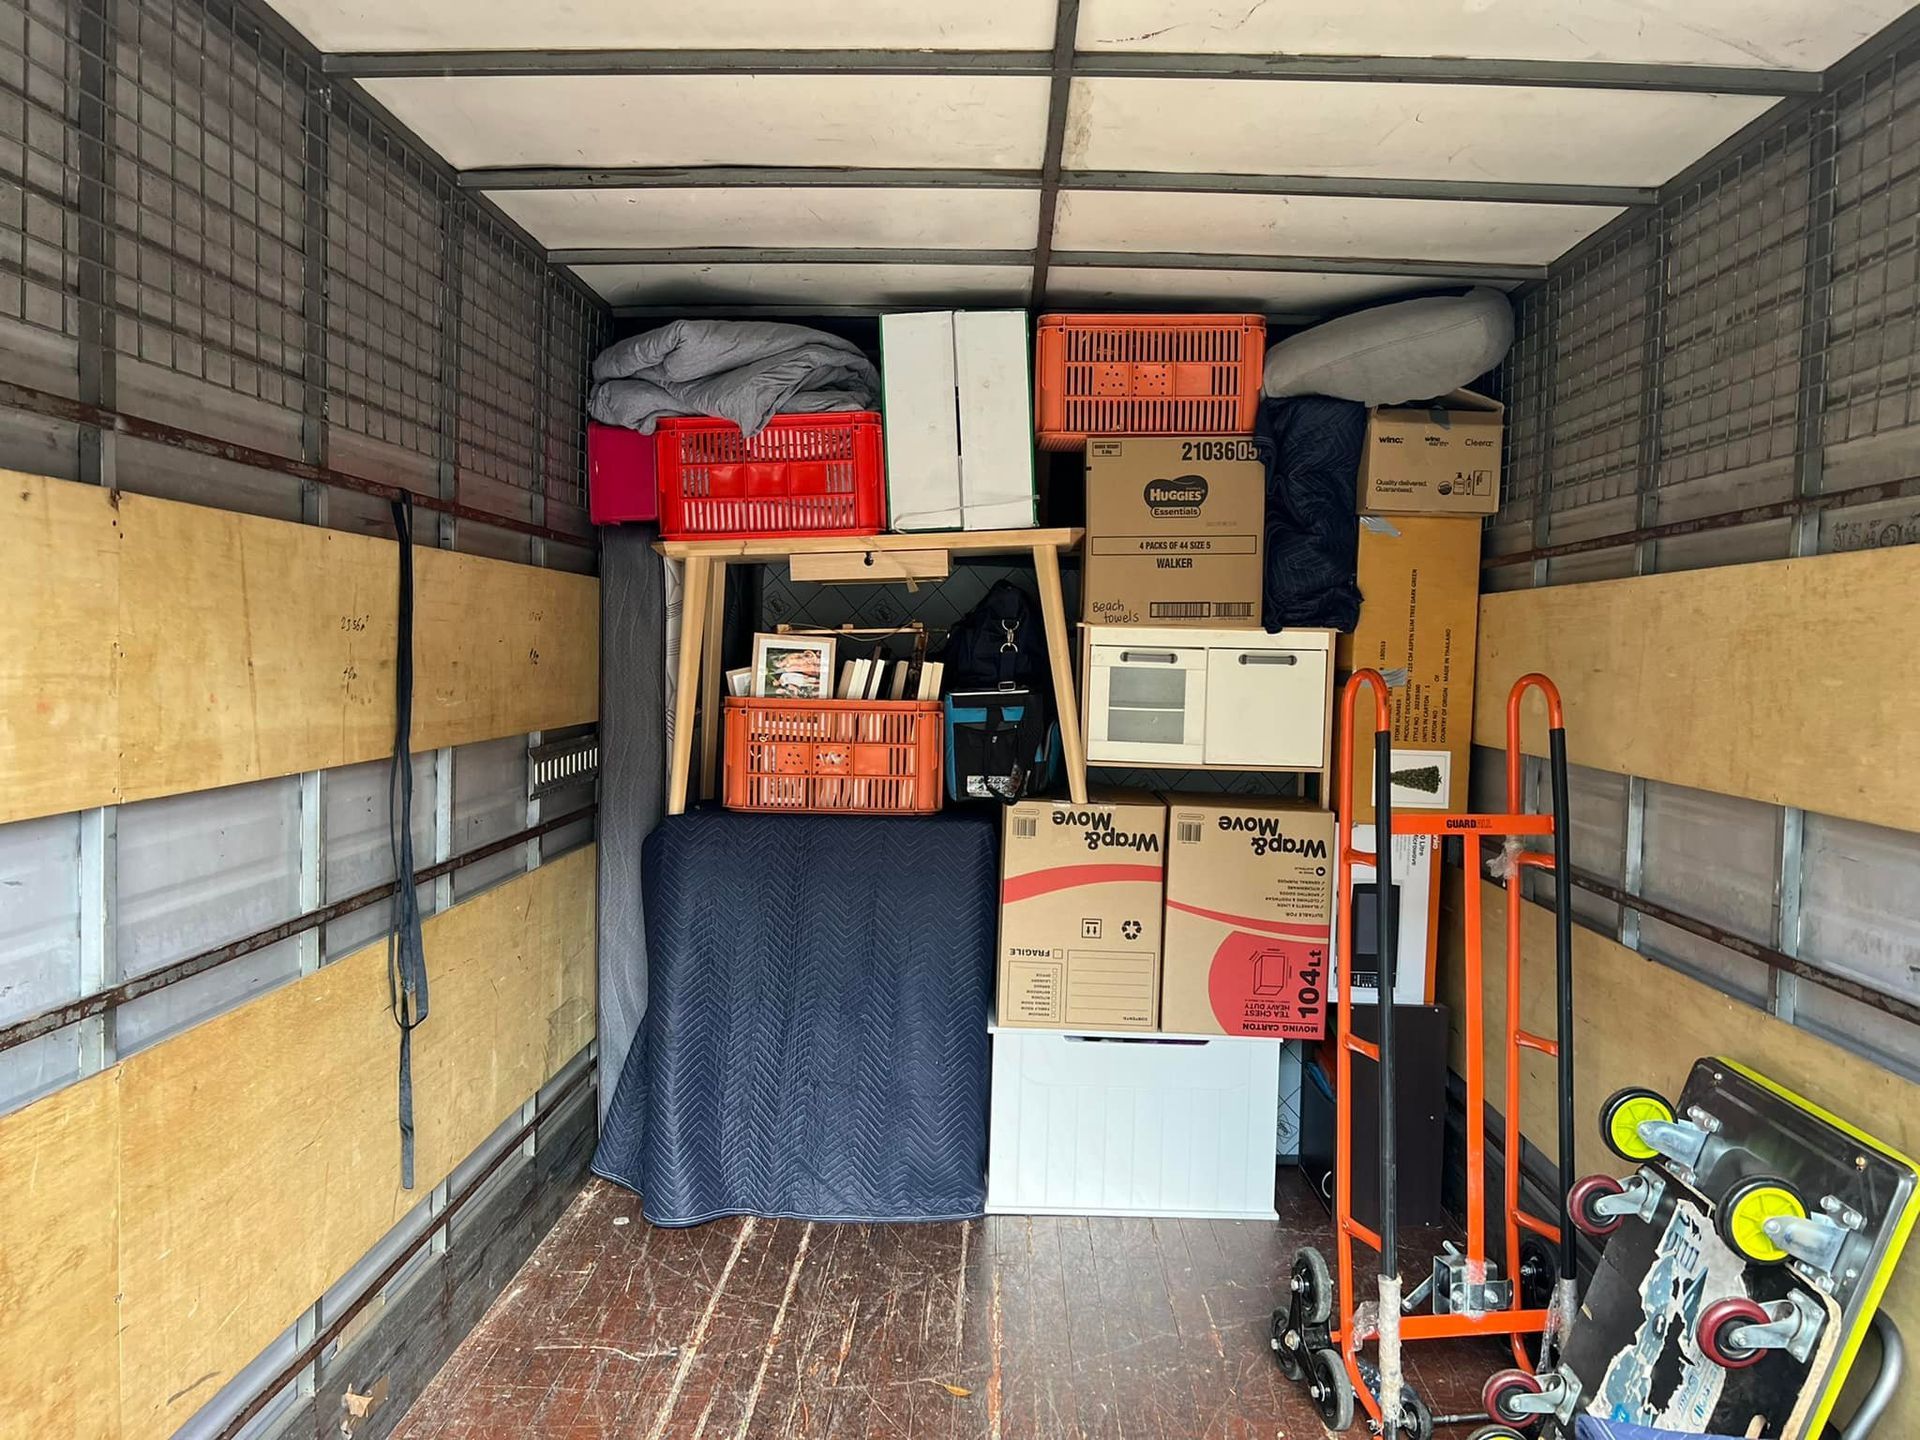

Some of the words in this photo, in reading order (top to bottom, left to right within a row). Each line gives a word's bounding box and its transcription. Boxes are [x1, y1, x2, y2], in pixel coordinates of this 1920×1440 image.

[1150, 488, 1201, 502] HUGGIES
[1154, 507, 1198, 516] Essentials
[1140, 541, 1144, 549] 4
[1146, 541, 1167, 549] PACKS
[1169, 541, 1178, 549] OF
[1179, 541, 1188, 549] 44
[1190, 541, 1205, 549] SIZE
[1206, 541, 1211, 549] 5
[1156, 558, 1193, 568] WALKER
[1092, 600, 1124, 613] Beach
[1104, 610, 1139, 624] towels
[1408, 652, 1414, 662] CM
[1441, 708, 1447, 716] OF
[1052, 811, 1112, 830] Move
[1218, 815, 1279, 836] Move
[1009, 948, 1050, 957] FRAGILE
[1242, 1023, 1279, 1031] CARTON
[1282, 1025, 1318, 1033] MOVING
